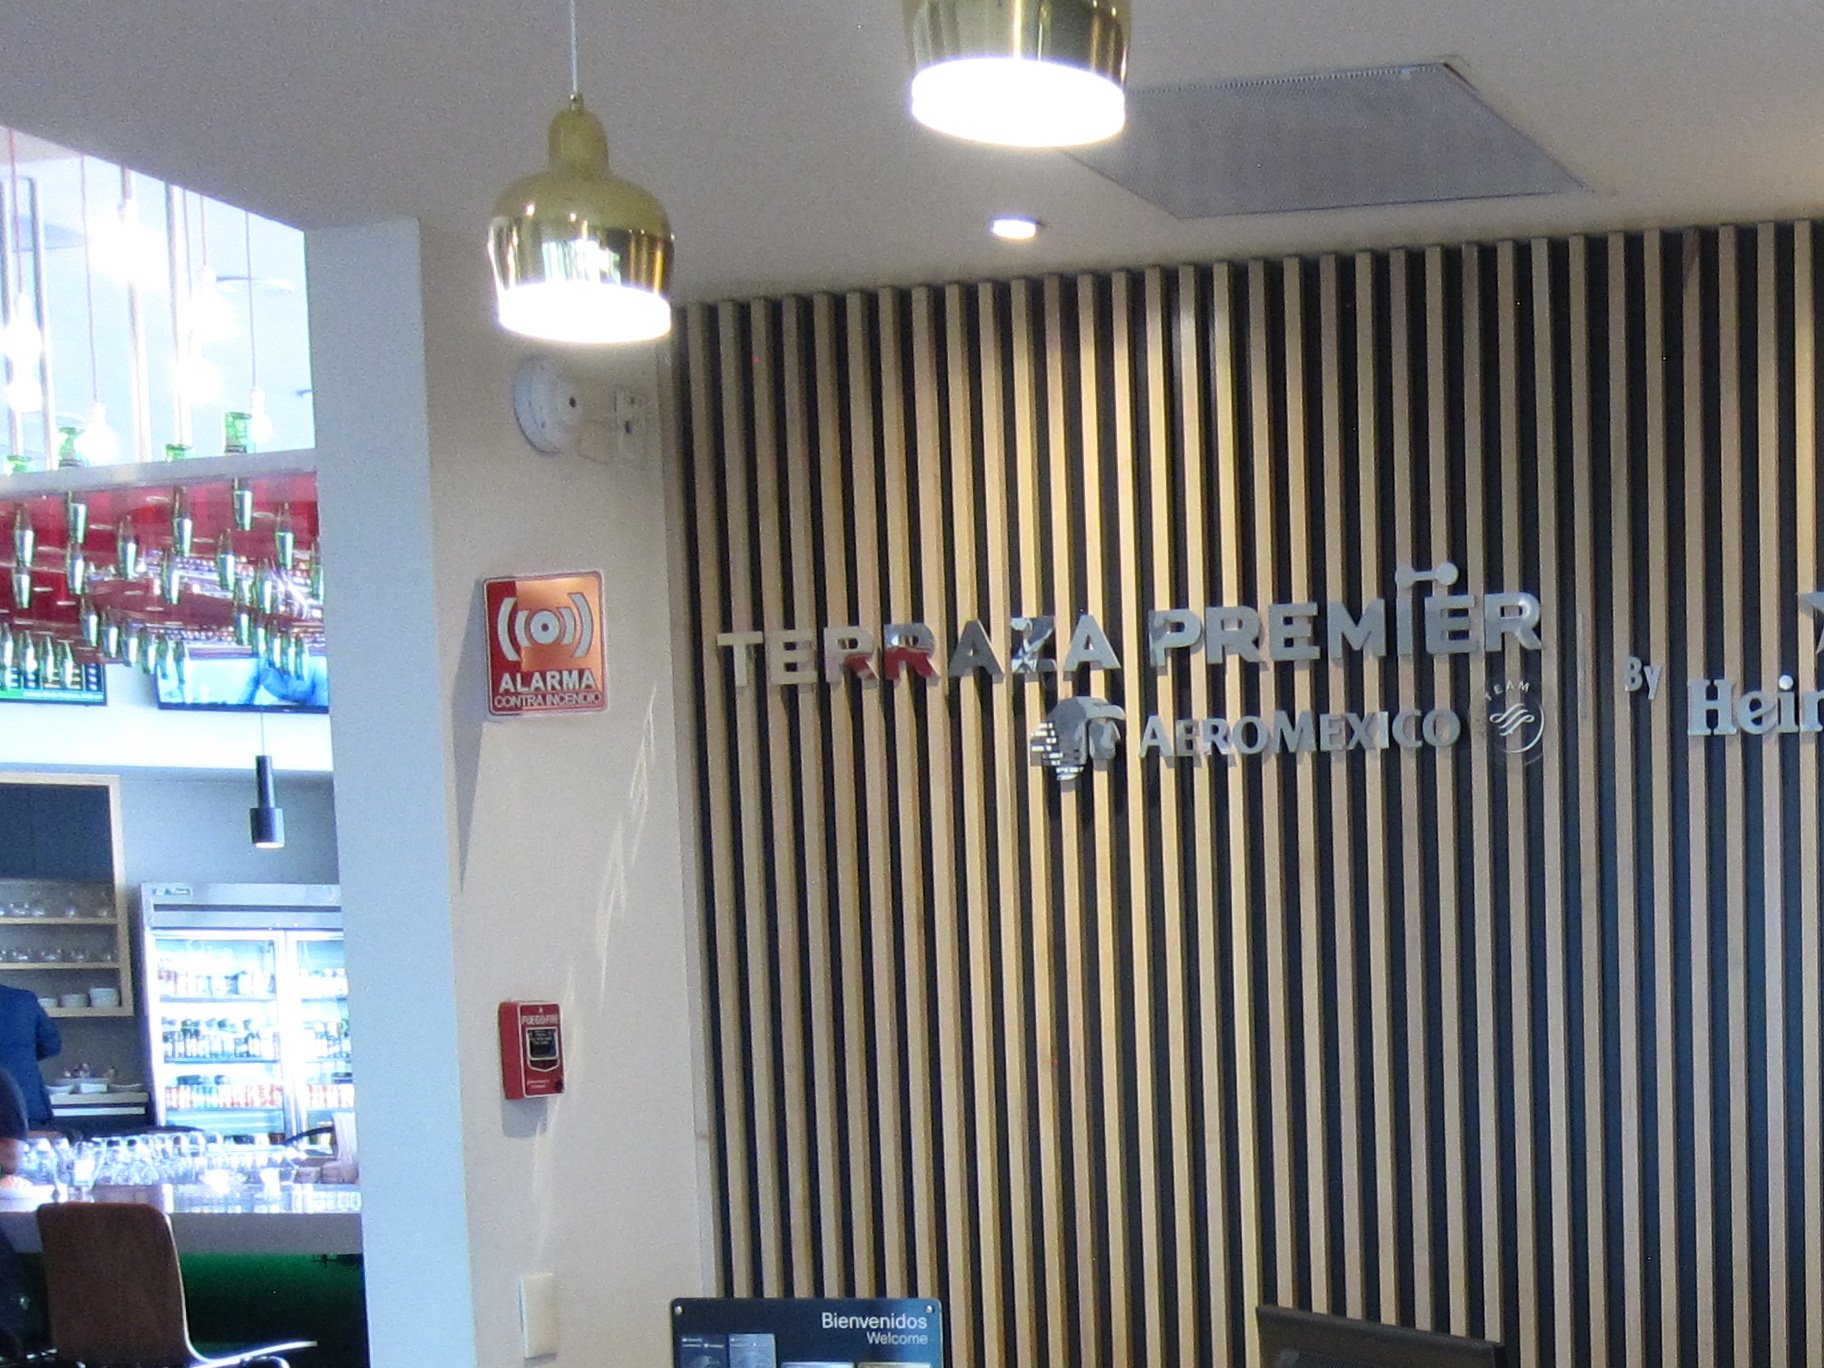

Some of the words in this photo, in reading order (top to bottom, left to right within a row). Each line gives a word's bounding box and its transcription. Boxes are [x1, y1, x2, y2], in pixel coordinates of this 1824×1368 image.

[715, 613, 1122, 687] TERRAZA
[1148, 592, 1543, 667] PREMIER
[498, 668, 598, 693] ALARMA
[1624, 655, 1663, 700] By
[494, 694, 543, 708] CONTRA
[1139, 707, 1461, 759] AEROMEXICO
[821, 1311, 928, 1330] Bienvenidos
[866, 1331, 929, 1346] Welcome
